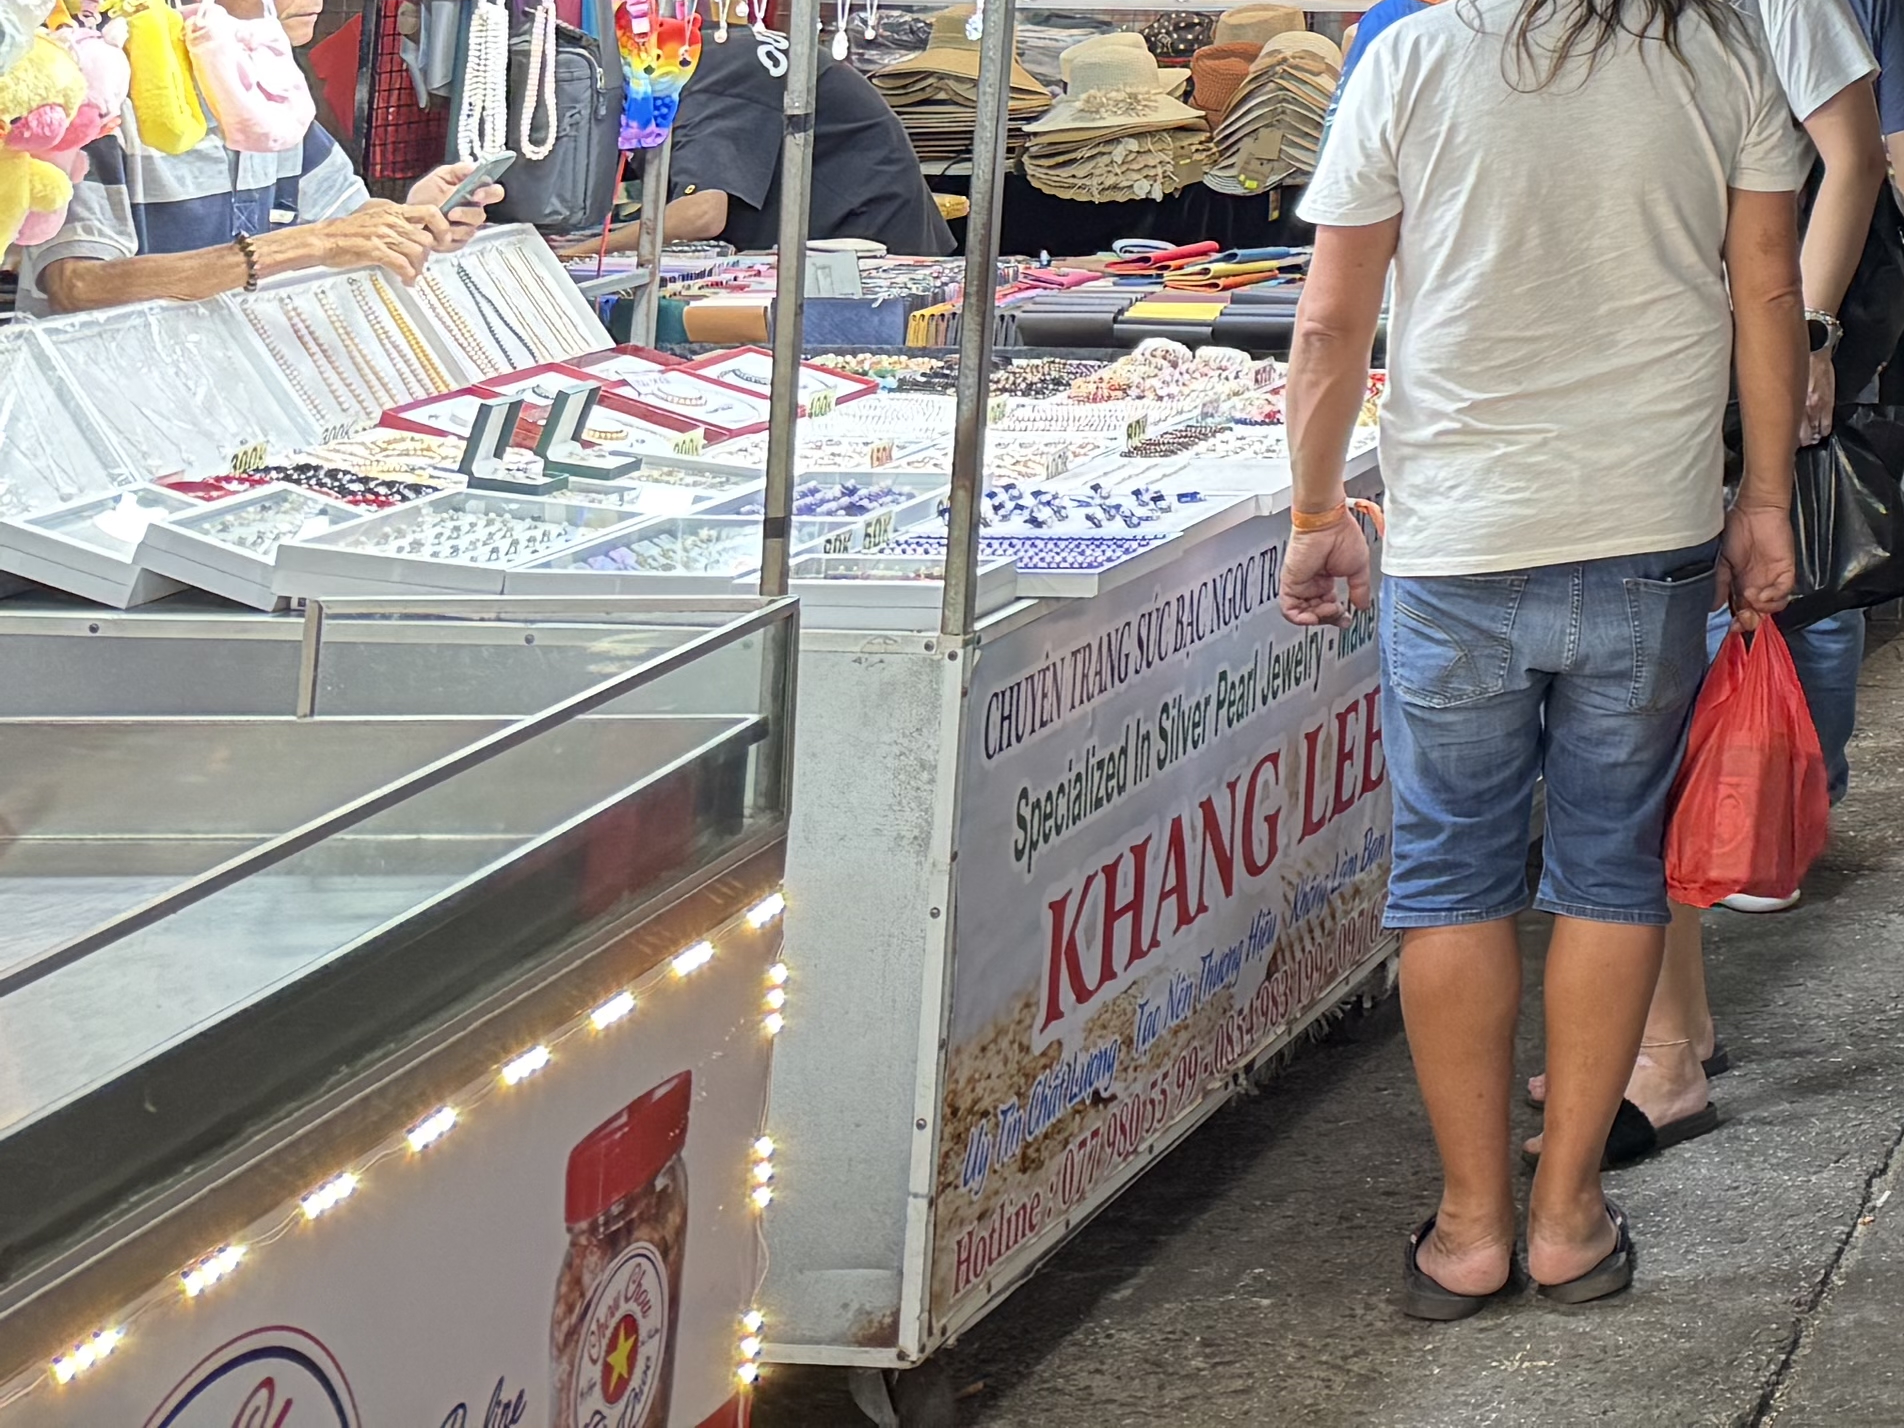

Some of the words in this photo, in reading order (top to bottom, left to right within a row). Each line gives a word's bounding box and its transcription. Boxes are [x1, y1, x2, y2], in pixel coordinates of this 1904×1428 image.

[984, 652, 1064, 761] CHUYÊN
[1068, 621, 1132, 714] TRANG
[1135, 593, 1171, 676] SỨC
[1172, 581, 1208, 661] BẠC
[1209, 555, 1255, 633] NGỌC
[1258, 539, 1287, 606] TR
[1014, 722, 1127, 874] Specialized
[1133, 717, 1151, 787] In
[1156, 690, 1211, 772] Silver
[1214, 649, 1258, 737] Pearl
[1261, 625, 1325, 705] Jewelry
[1040, 748, 1283, 1034] KHANG
[1297, 684, 1386, 845] LEE
[953, 1190, 1041, 1295] Hotline
